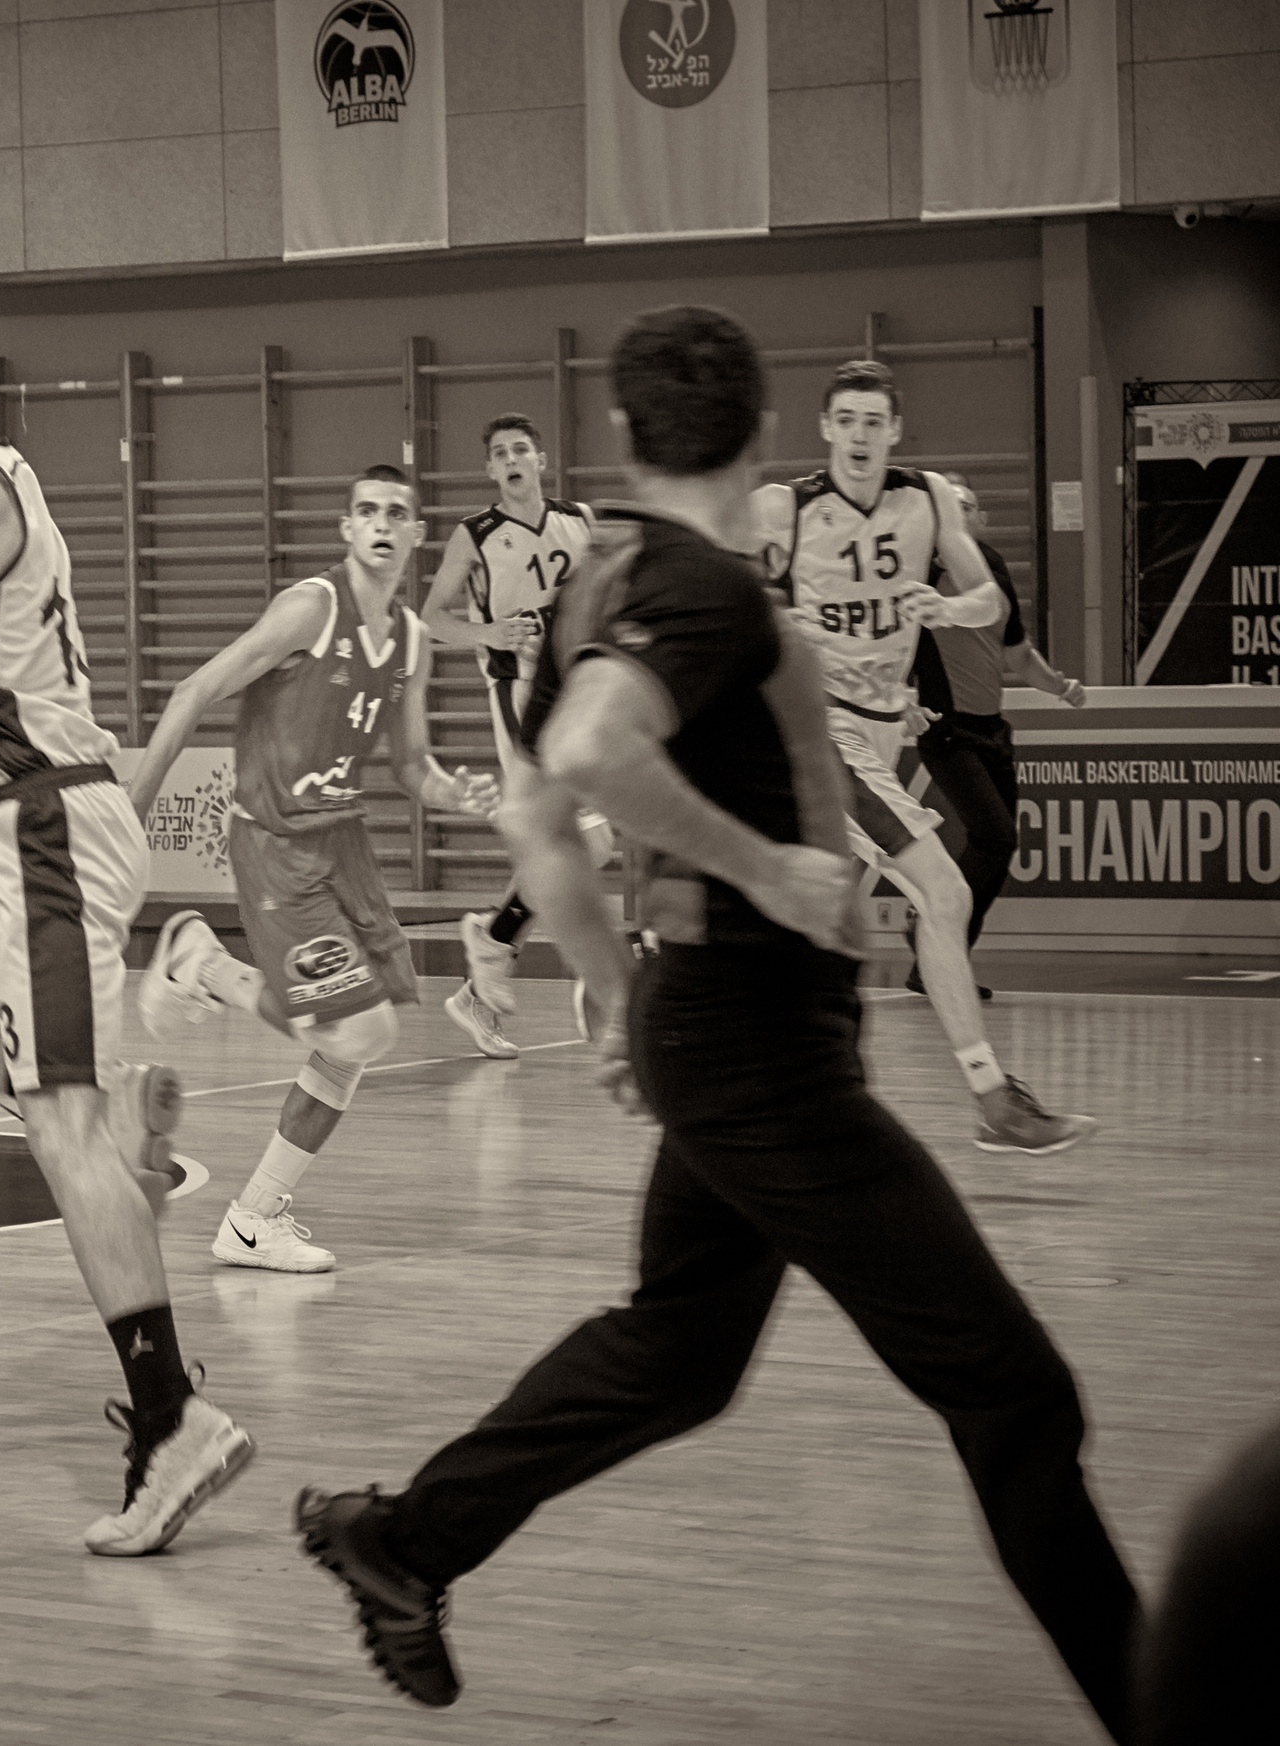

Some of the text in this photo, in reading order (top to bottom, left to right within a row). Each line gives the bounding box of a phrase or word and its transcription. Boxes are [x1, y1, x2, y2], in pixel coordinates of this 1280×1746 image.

[329, 74, 404, 110] ALBA
[337, 103, 397, 125] BERLIN
[526, 550, 570, 591] 12
[839, 533, 901, 582] 15
[1231, 565, 1280, 605] INT
[346, 691, 383, 734] 41
[1013, 761, 1083, 784] ATIONAL
[1086, 761, 1189, 784] BASKETBALL
[174, 793, 195, 814] תל
[157, 816, 194, 832] אביב
[1008, 798, 1280, 884] CHAMPIO
[173, 834, 193, 851] יפו
